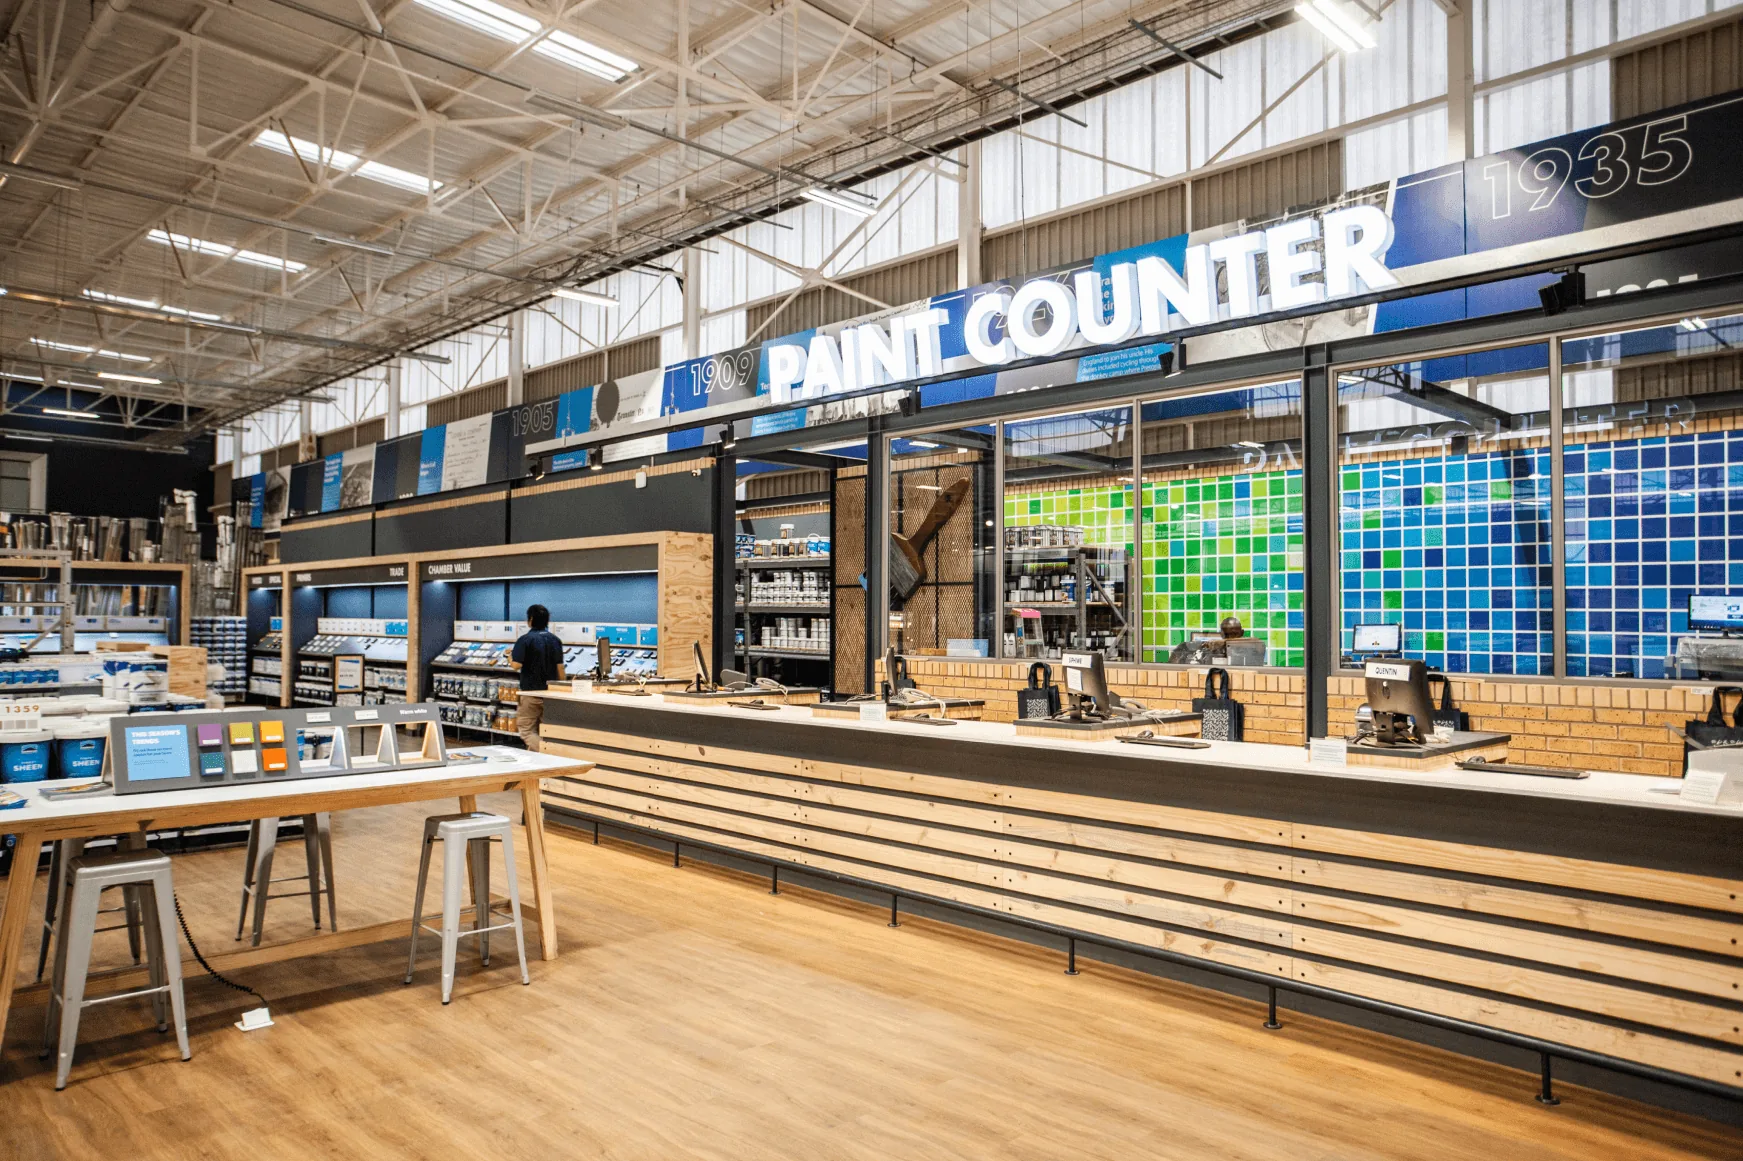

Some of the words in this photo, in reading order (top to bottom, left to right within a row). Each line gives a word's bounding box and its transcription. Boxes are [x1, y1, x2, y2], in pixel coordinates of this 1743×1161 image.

[1483, 115, 1693, 220] 1935
[768, 308, 948, 404] PAINT
[964, 205, 1400, 365] COUNTER
[1083, 357, 1105, 366] England
[1110, 354, 1120, 363] join
[1098, 361, 1120, 371] included
[1120, 359, 1138, 368] cycling
[691, 352, 753, 396] 1909
[512, 402, 553, 436] 1905
[389, 567, 404, 577] TRADE
[428, 564, 453, 575] CHAMBER
[454, 562, 471, 573] VALUE
[1375, 666, 1398, 676] QUENTIN
[13, 763, 43, 772] SHEEN
[72, 759, 100, 767] SHEEN
